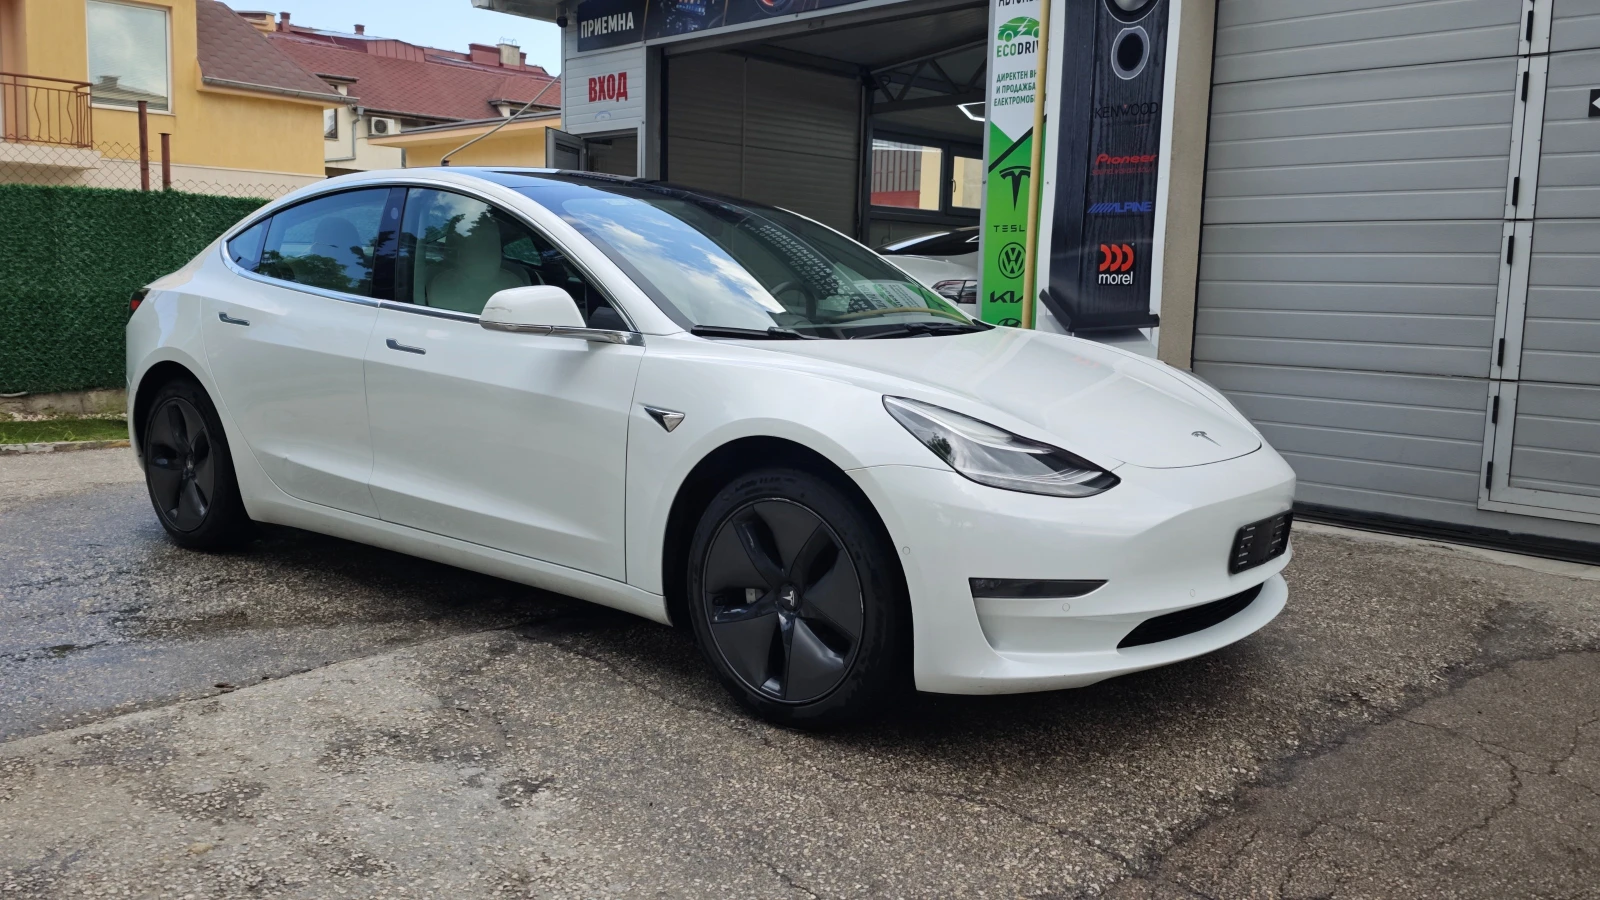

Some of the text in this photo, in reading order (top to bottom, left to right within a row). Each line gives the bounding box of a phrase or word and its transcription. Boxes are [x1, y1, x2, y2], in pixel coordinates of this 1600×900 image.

[581, 11, 635, 39] ПРИЕМНА
[996, 70, 1028, 83] ДИРЕКТЕН
[588, 72, 628, 102] ВХОД
[993, 94, 1035, 107] ЕЛЕКТРОМОБ
[1095, 102, 1159, 119] KENWOOD
[1095, 153, 1157, 166] Pioneer
[1104, 201, 1153, 213] ALPINE
[993, 224, 1026, 233] TESL
[1098, 271, 1134, 285] morel
